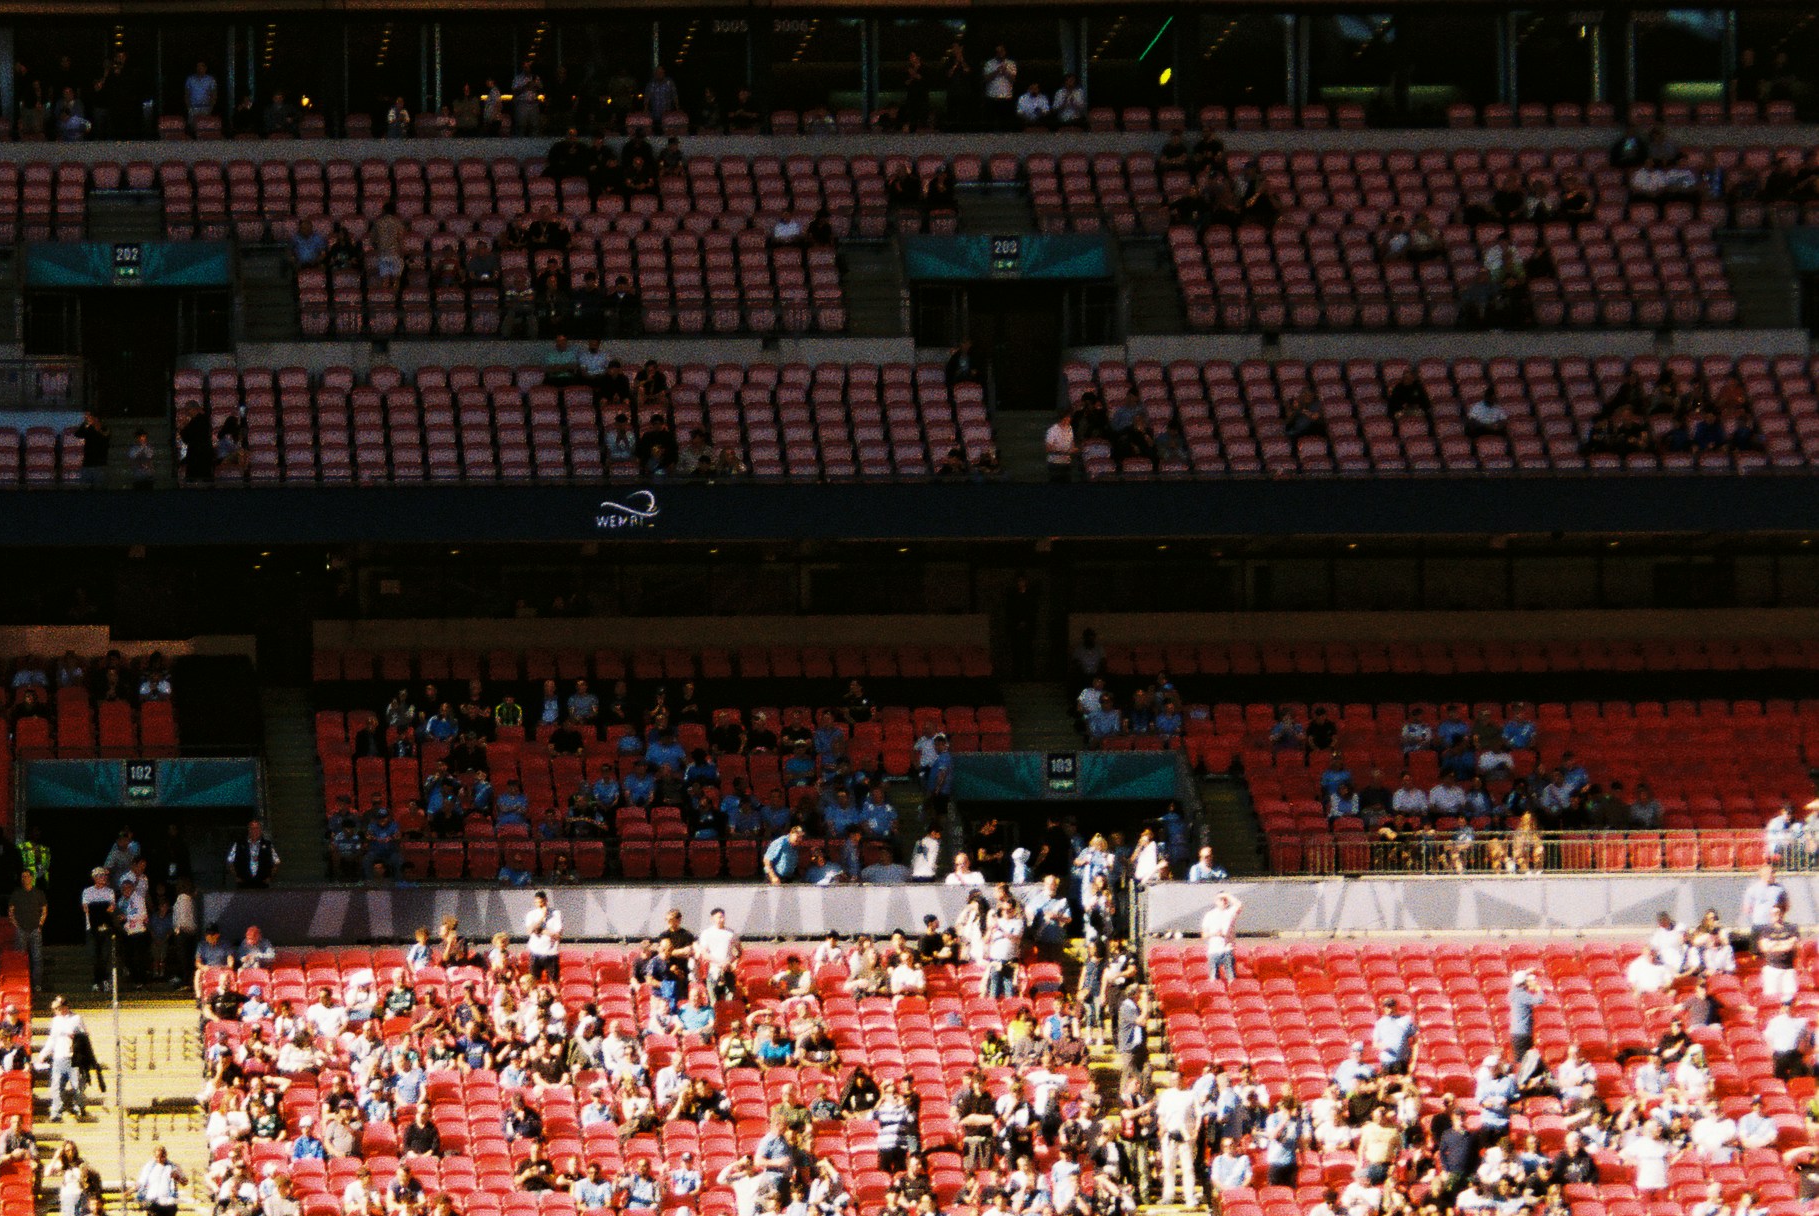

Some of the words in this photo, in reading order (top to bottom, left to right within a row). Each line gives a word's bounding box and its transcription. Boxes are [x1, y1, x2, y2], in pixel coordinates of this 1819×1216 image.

[713, 19, 748, 33] 3005
[115, 246, 139, 261] 202
[994, 240, 1018, 254] 203
[130, 764, 152, 780] 102
[1050, 757, 1074, 772] 103
